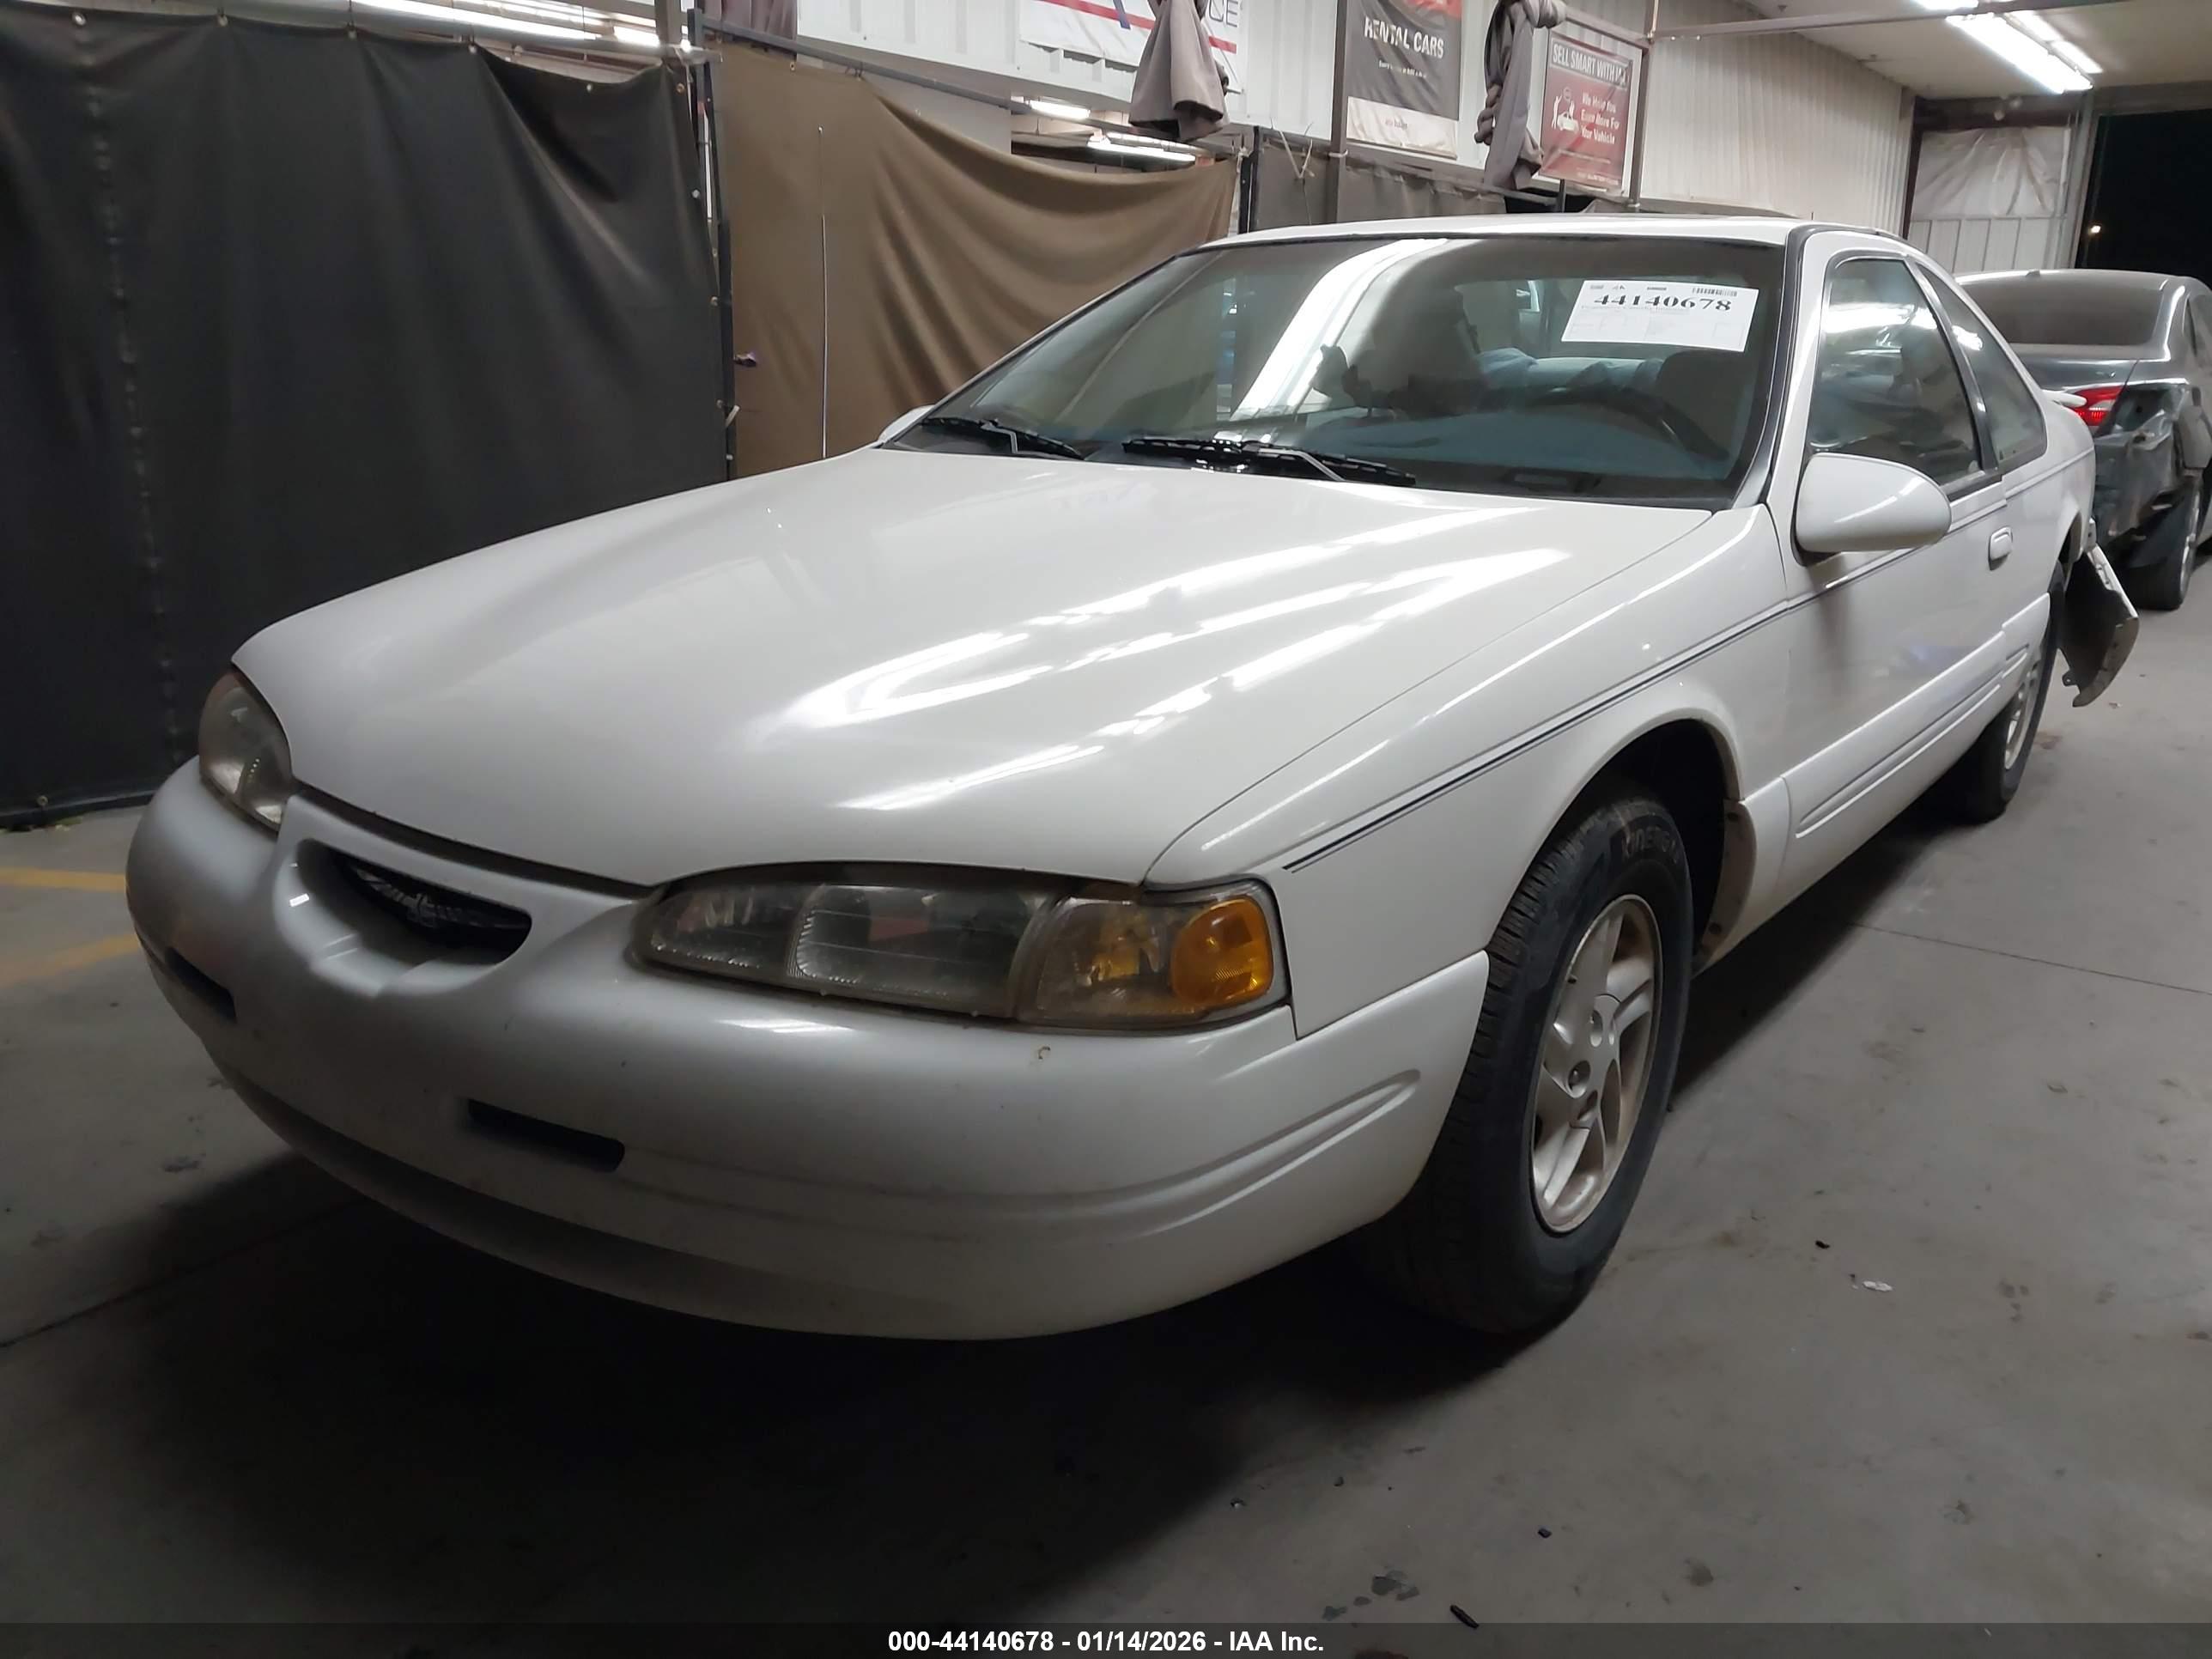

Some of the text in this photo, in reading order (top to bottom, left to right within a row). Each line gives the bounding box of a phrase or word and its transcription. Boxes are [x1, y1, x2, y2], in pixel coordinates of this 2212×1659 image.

[1364, 15, 1444, 59] RENTAL CARS
[1553, 43, 1570, 67] SELL
[1571, 51, 1596, 75] SMART
[1594, 294, 1732, 312] 44140678
